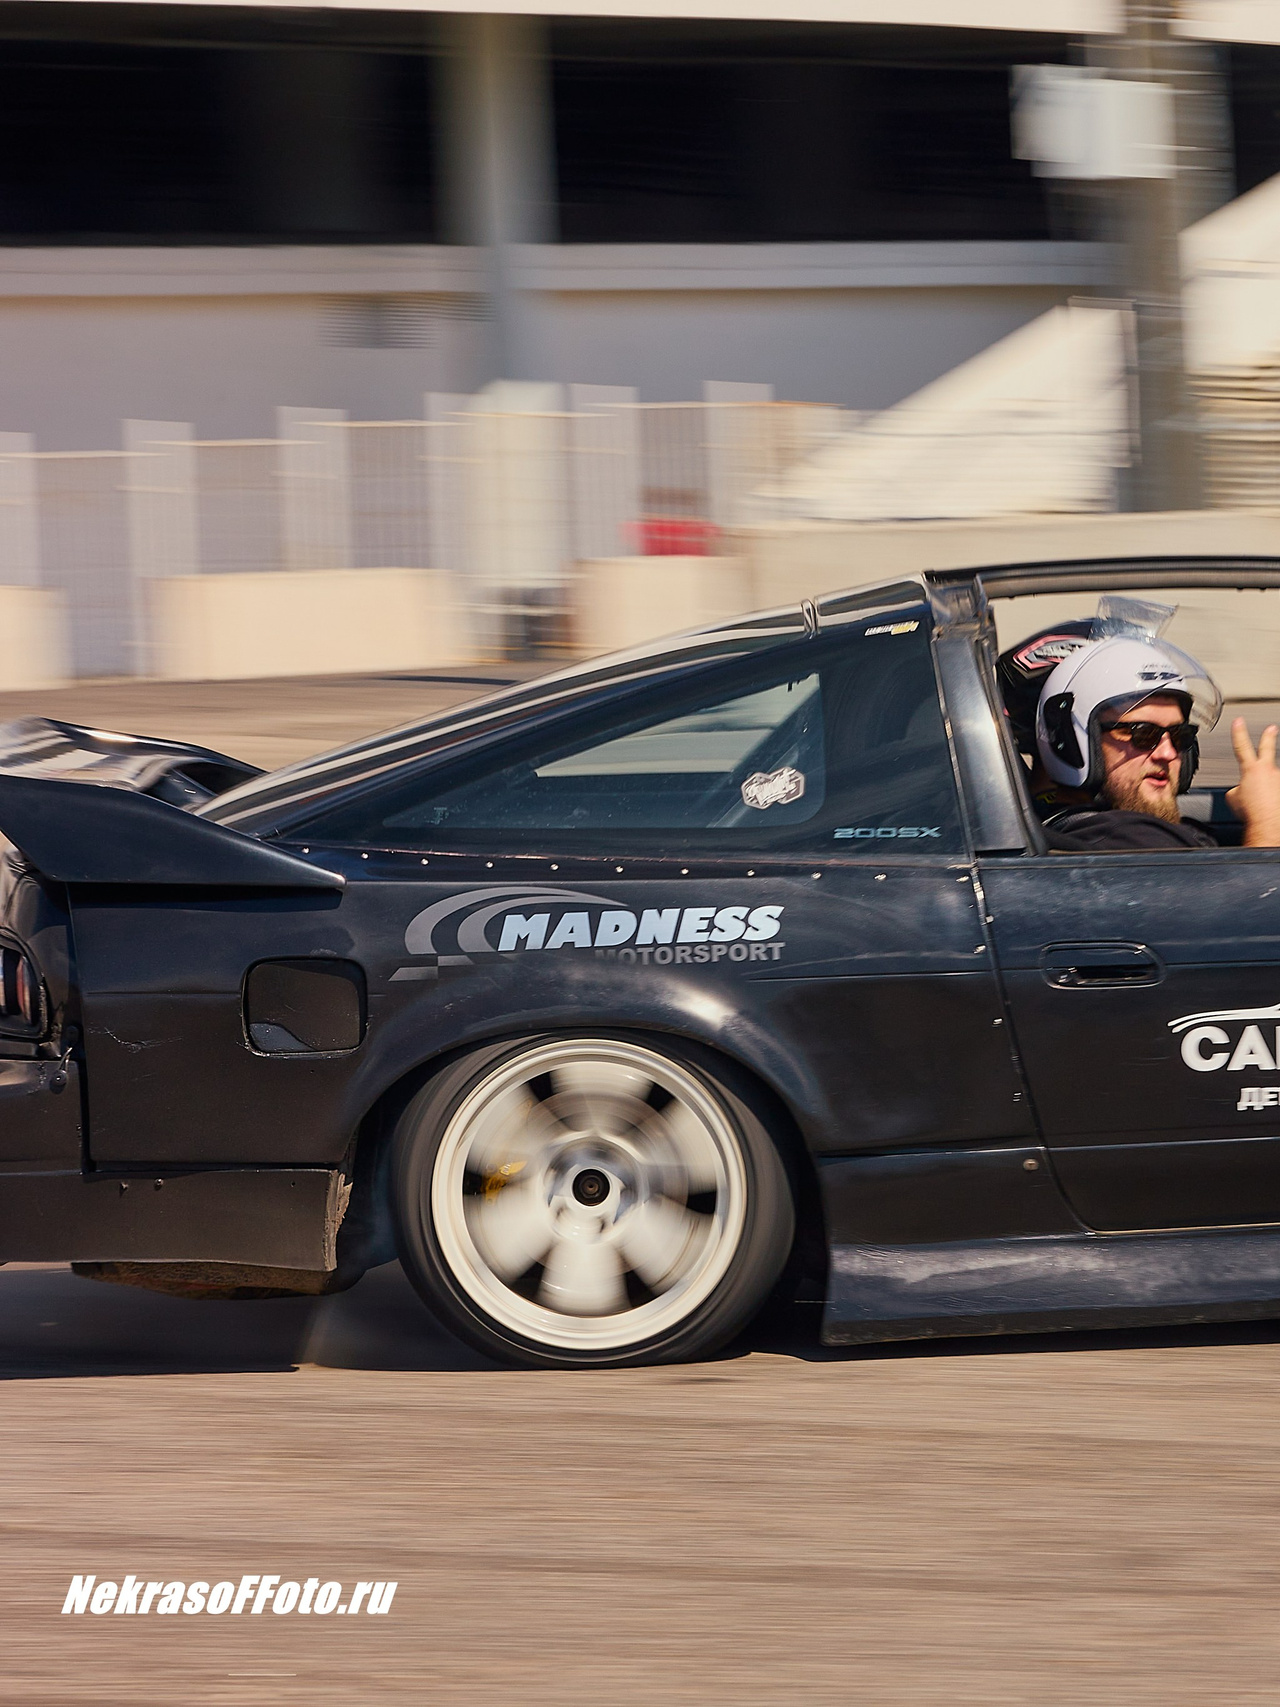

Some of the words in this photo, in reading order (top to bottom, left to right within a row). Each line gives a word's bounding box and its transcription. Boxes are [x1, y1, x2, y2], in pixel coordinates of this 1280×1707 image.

[833, 826, 942, 839] 200SX
[497, 905, 785, 952] MADNESS
[593, 941, 787, 966] MOTORSPORT
